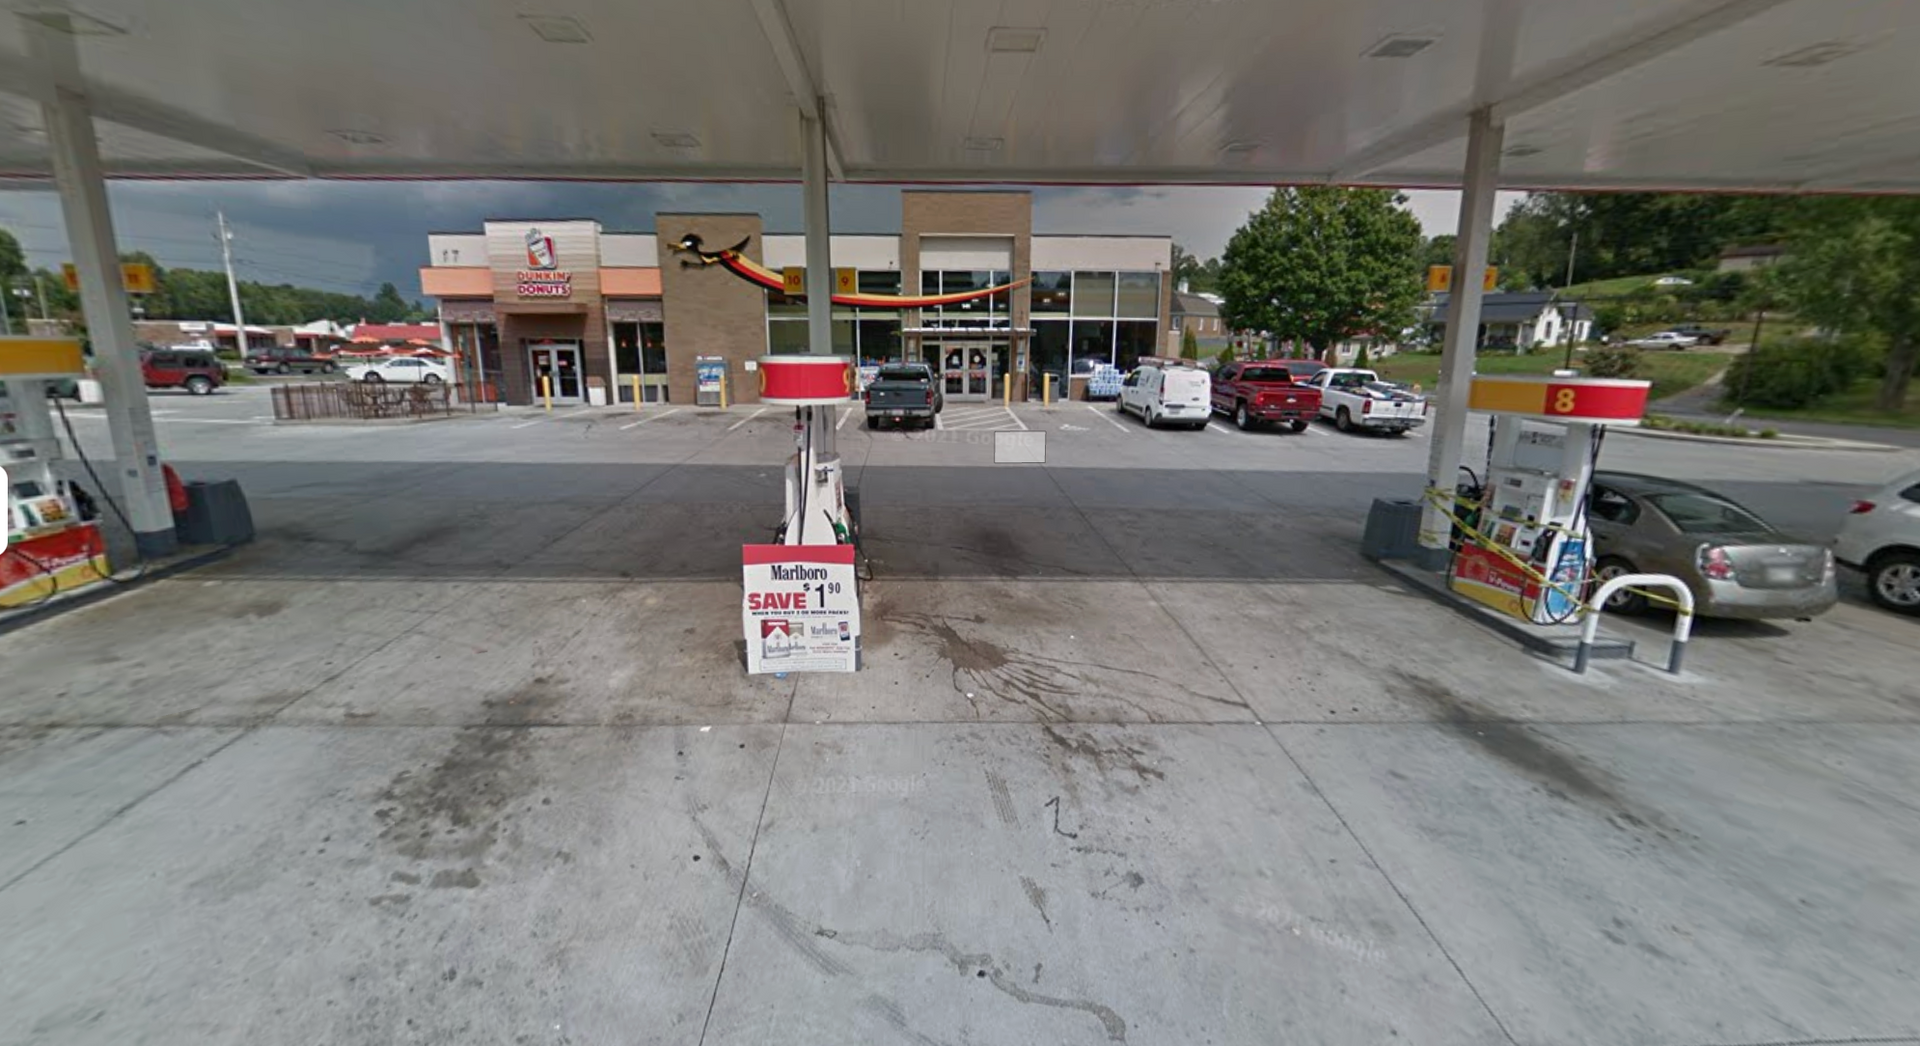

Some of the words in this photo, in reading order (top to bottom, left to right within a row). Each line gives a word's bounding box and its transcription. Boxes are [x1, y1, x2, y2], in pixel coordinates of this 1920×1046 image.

[787, 275, 801, 285] 10
[841, 276, 849, 286] 9
[518, 284, 571, 294] DONUTS
[1554, 388, 1576, 413] 8
[771, 564, 828, 581] Marlboro
[748, 592, 807, 610] SAVE
